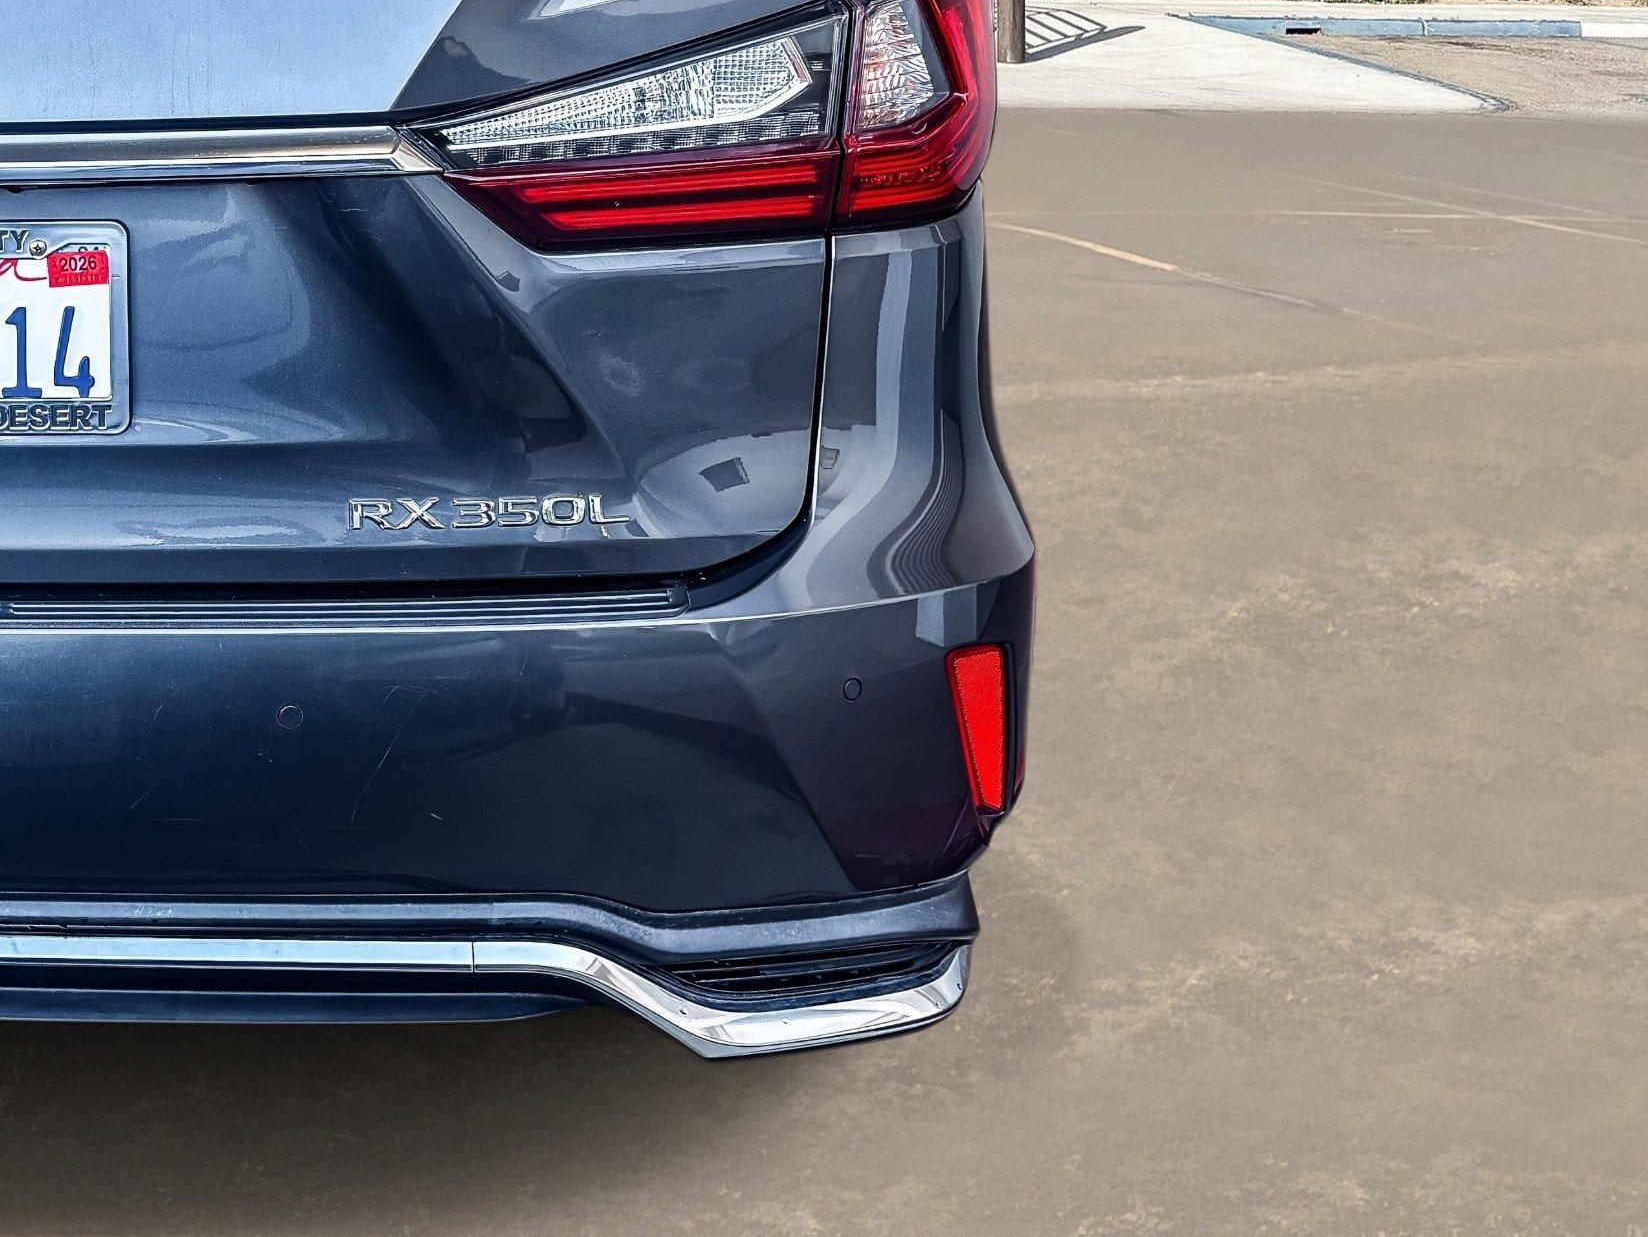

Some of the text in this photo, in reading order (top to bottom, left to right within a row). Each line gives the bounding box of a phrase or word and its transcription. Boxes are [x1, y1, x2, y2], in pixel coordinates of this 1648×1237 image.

[59, 255, 98, 272] 2026
[348, 493, 631, 530] RX 350L
